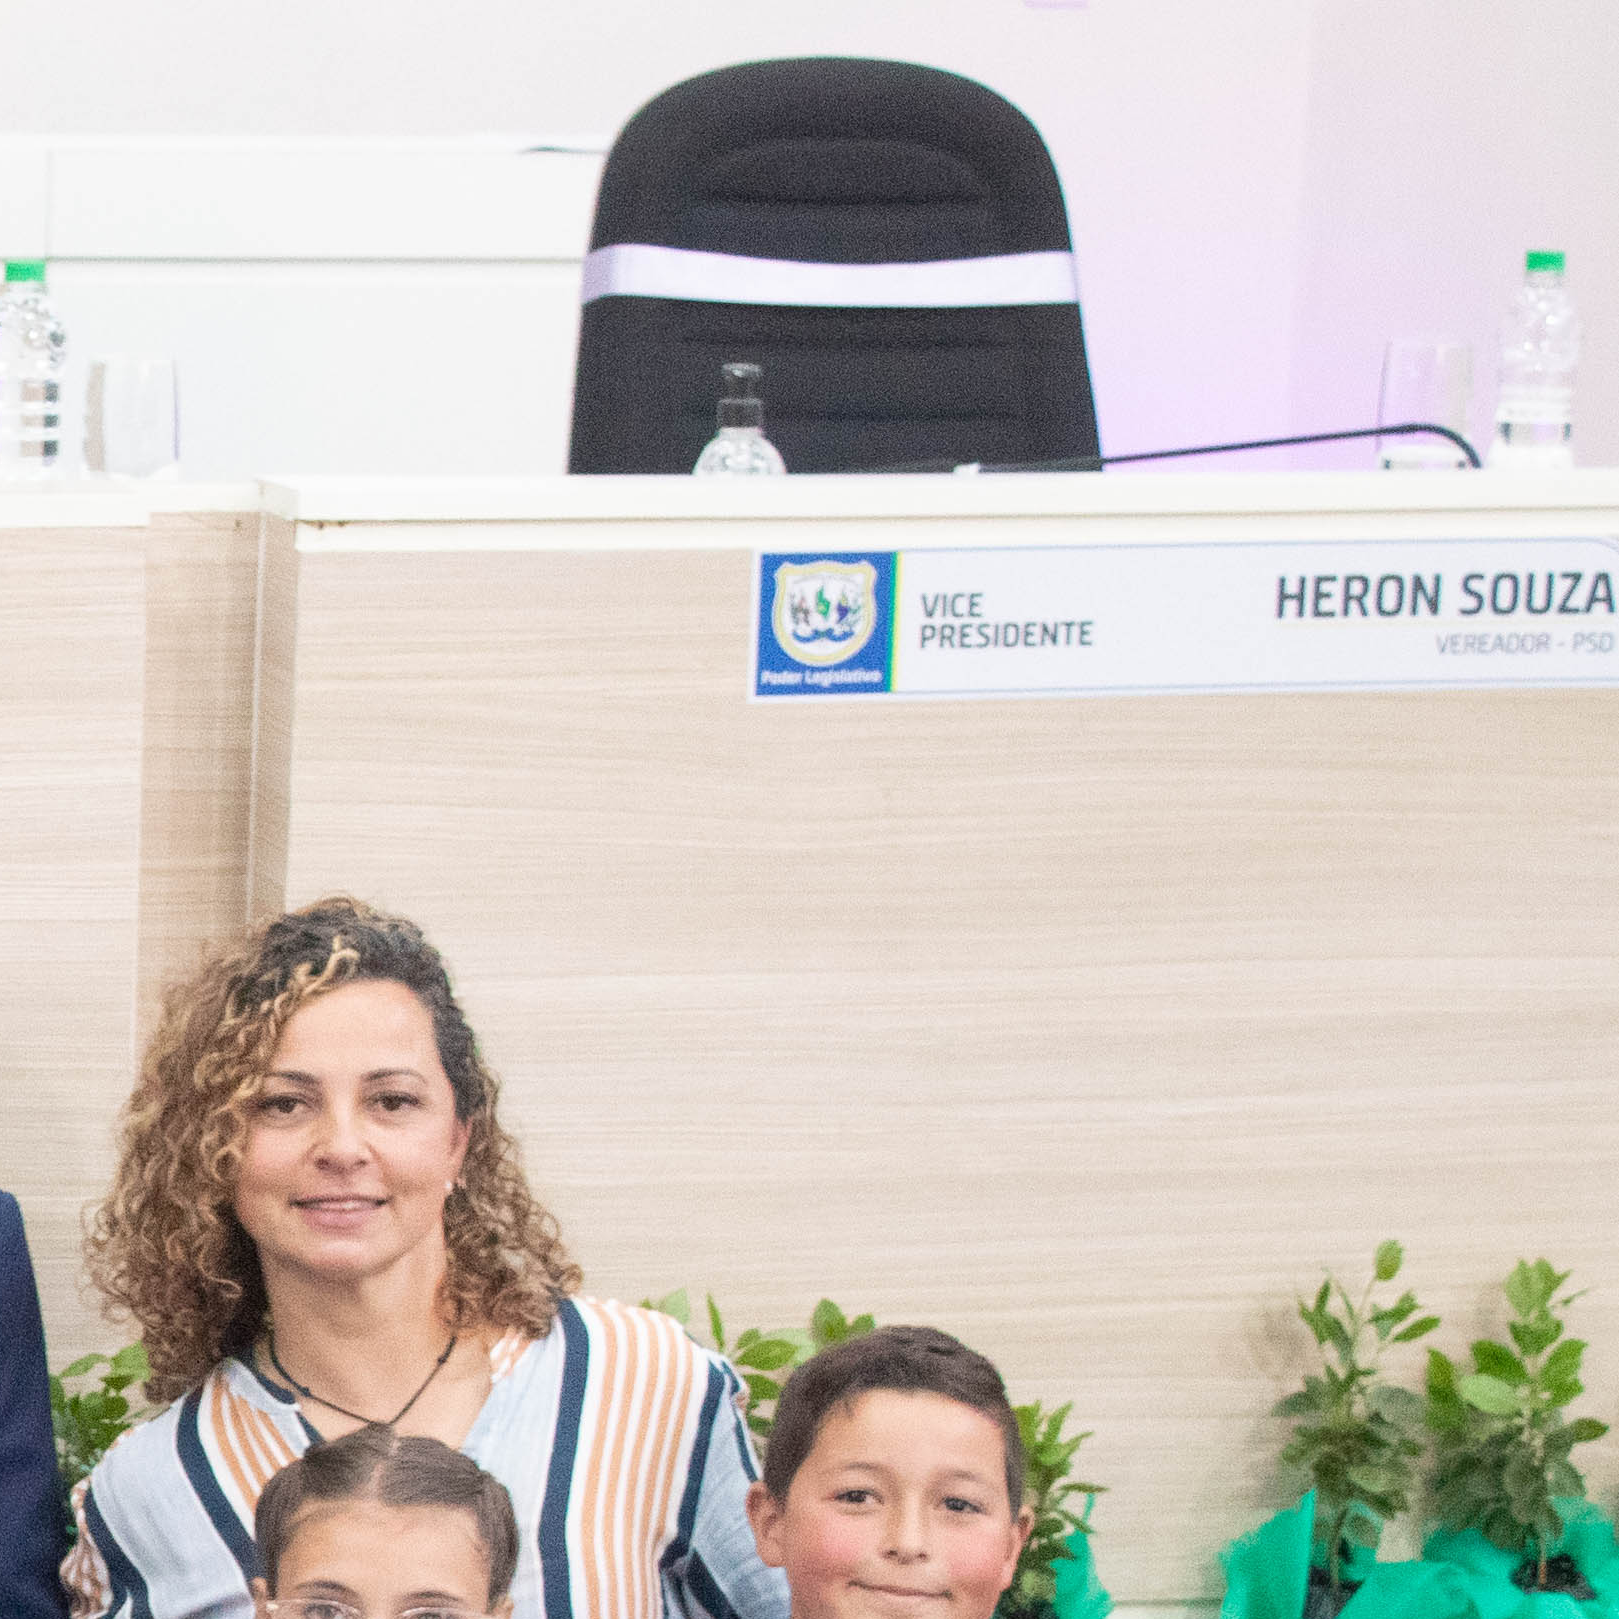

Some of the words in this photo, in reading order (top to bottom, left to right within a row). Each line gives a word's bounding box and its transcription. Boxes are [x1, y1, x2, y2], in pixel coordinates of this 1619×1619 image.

[921, 592, 983, 618] VICE
[1276, 573, 1441, 618] HERON
[1458, 571, 1616, 616] SOUZA
[920, 621, 1093, 649] PRESIDENTE
[1435, 632, 1551, 657] VEREADOR
